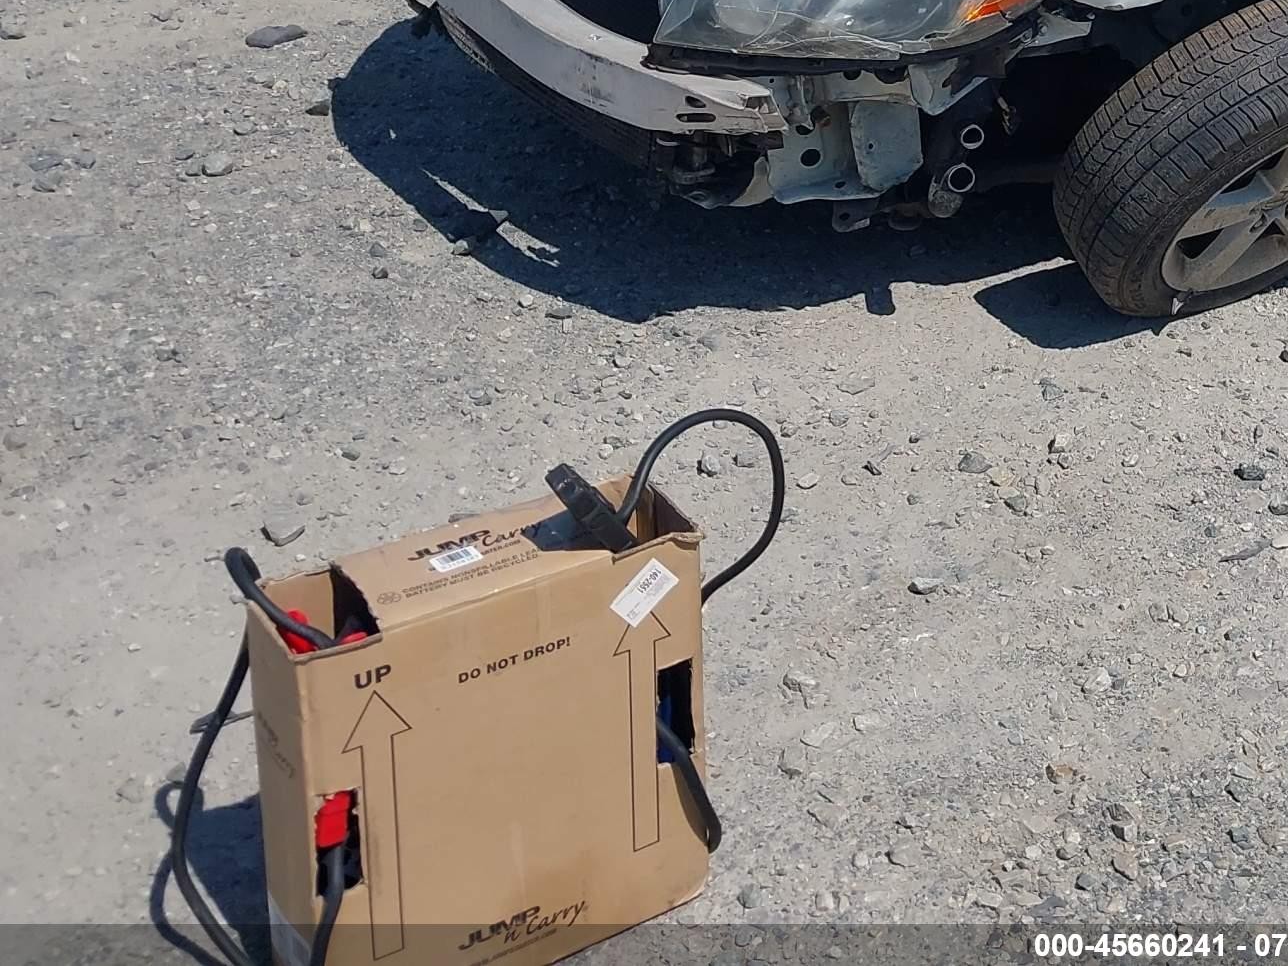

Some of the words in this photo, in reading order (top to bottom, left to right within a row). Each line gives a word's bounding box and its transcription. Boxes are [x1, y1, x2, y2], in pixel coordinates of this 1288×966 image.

[408, 529, 490, 562] JUMP
[405, 582, 447, 598] BATTERY
[449, 574, 474, 585] MUST
[477, 569, 489, 577] BE
[353, 663, 392, 690] UP
[457, 667, 481, 684] DO
[486, 654, 519, 675] NOT
[523, 636, 571, 662] DROP!
[457, 905, 541, 951] JUMP
[526, 900, 585, 935] Carry
